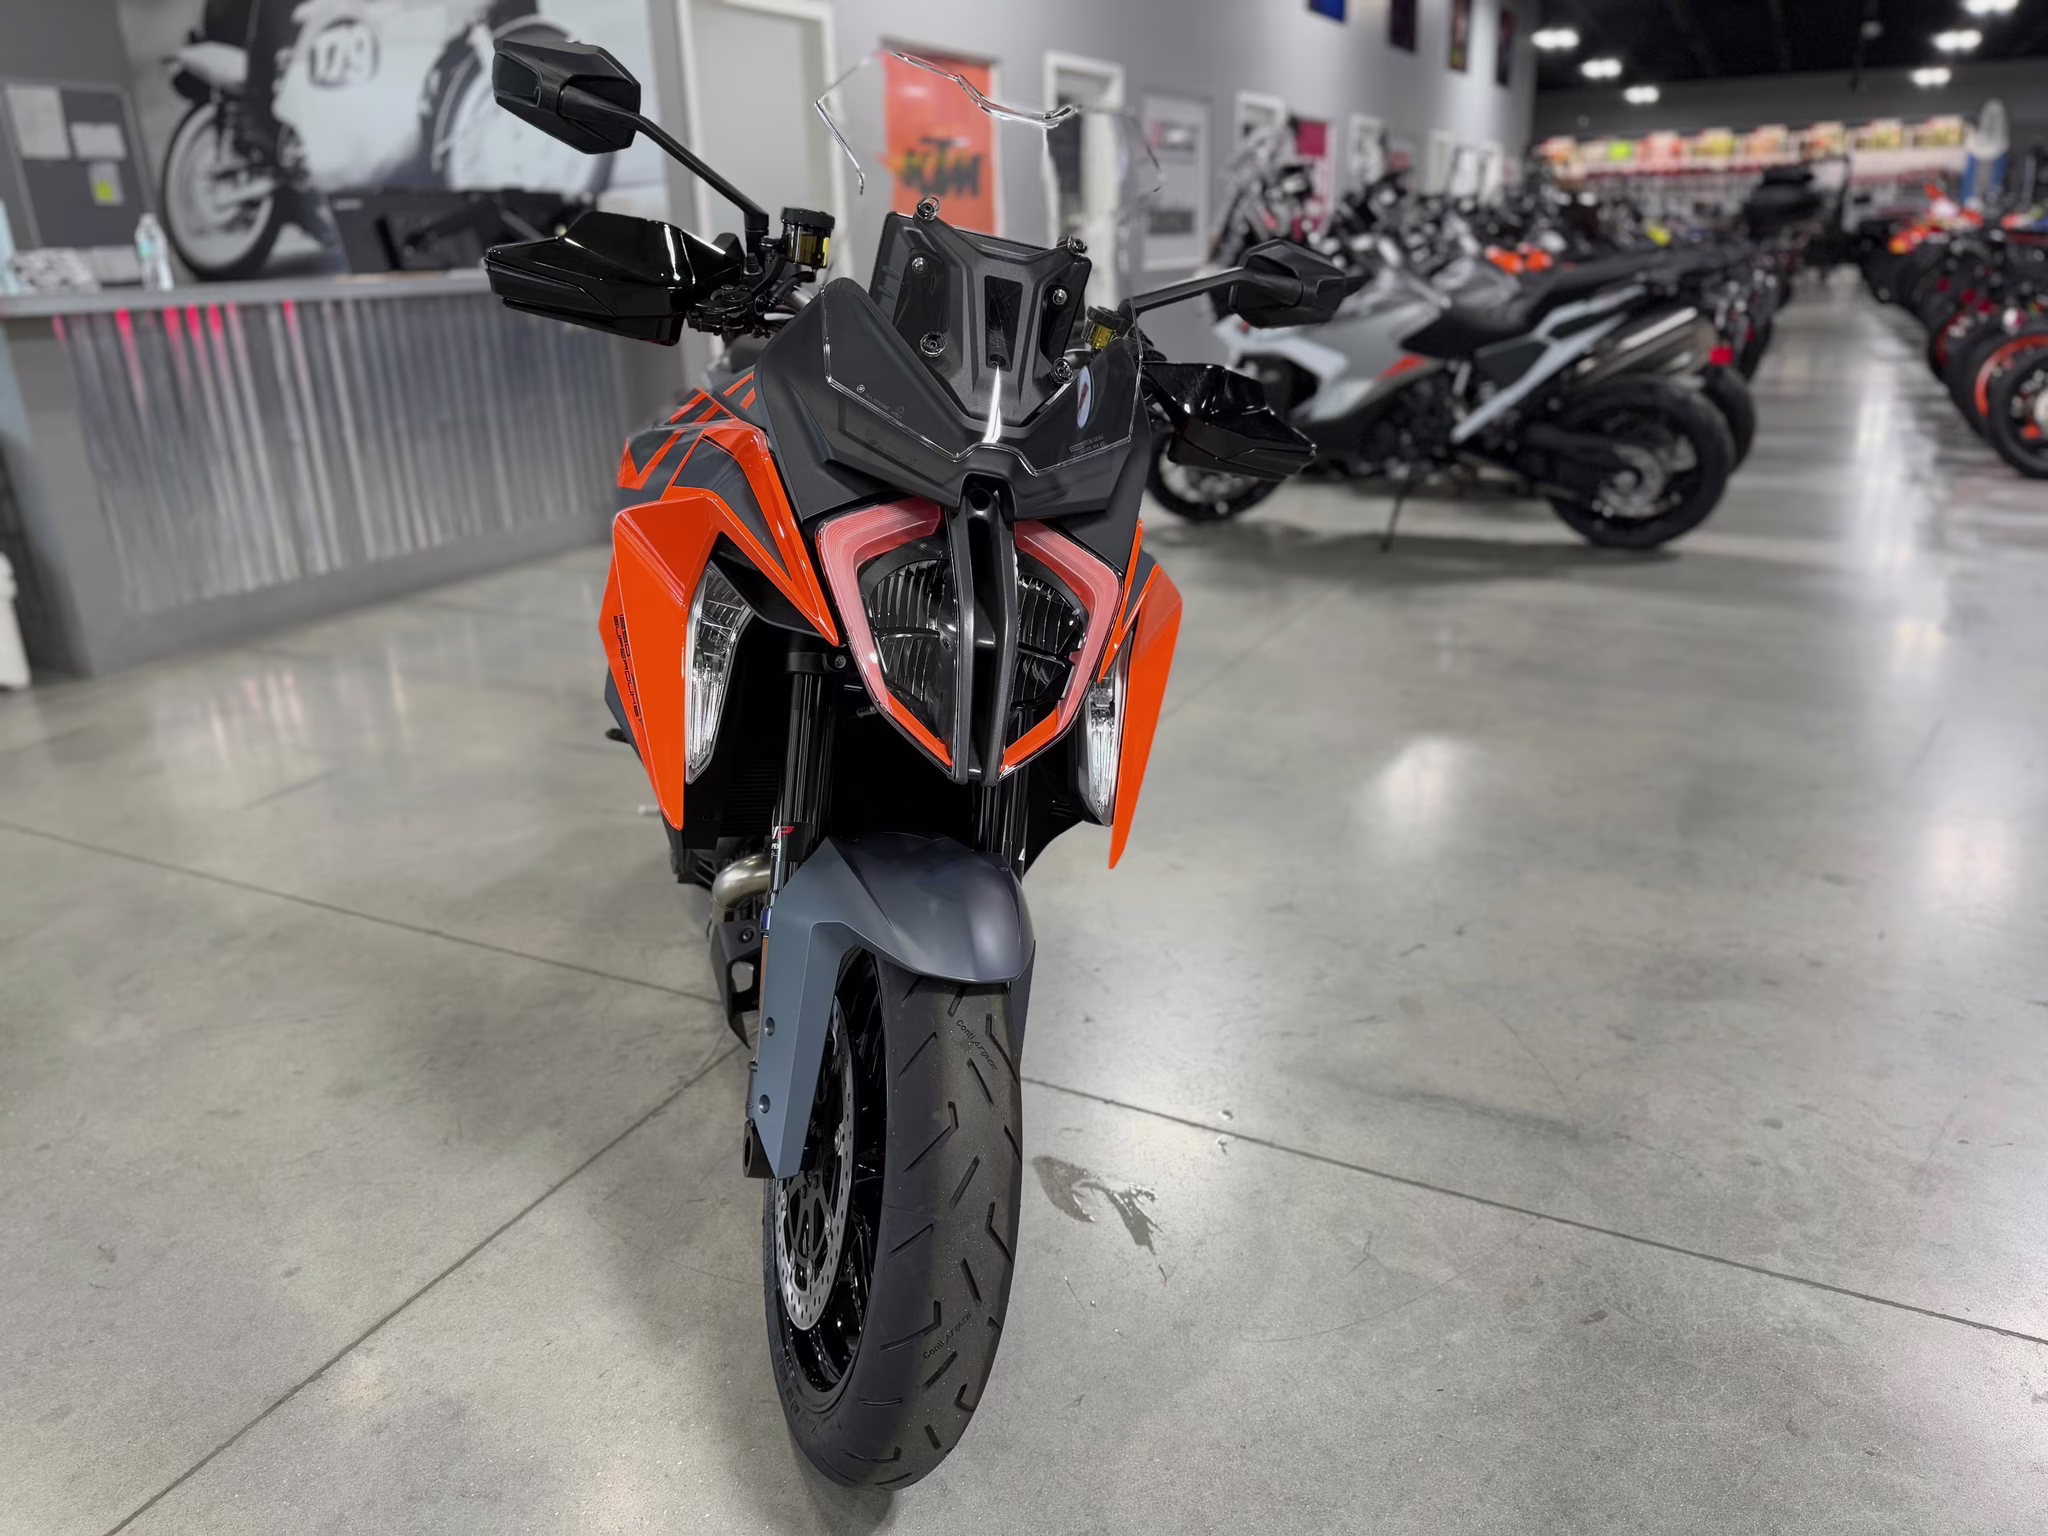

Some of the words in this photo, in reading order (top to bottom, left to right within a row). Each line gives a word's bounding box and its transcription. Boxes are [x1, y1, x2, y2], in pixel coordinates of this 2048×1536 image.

[901, 135, 981, 197] KTM
[956, 1019, 976, 1040] Conti
[923, 1339, 945, 1358] Conti
